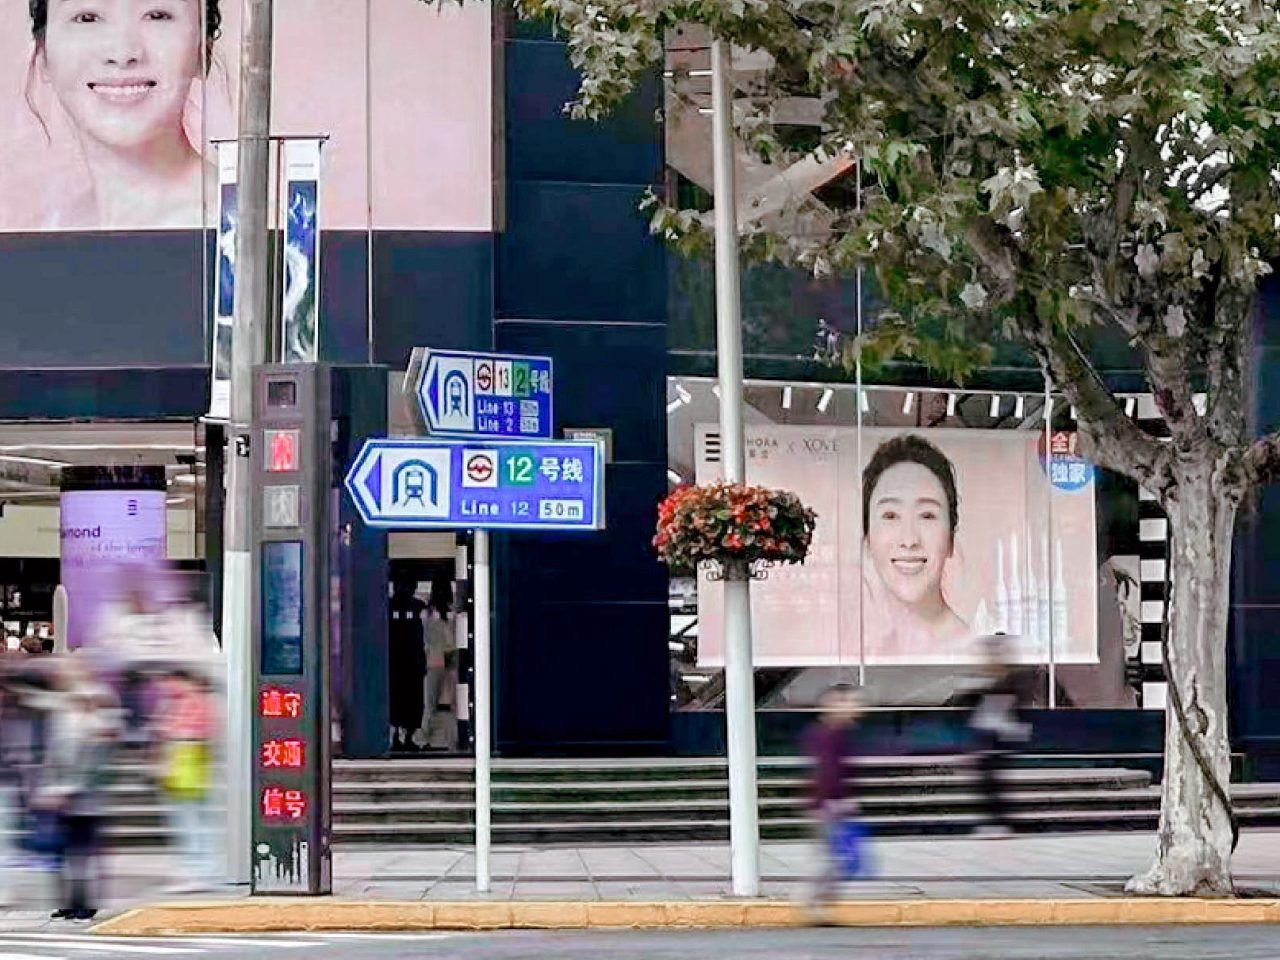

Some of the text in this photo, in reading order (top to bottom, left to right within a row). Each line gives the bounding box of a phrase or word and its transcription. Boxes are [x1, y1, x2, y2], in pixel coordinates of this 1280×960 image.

[1051, 462, 1086, 483] 独家
[461, 499, 581, 517] Line 12 50m
[263, 740, 301, 767] 交通
[263, 788, 305, 818] 信号
